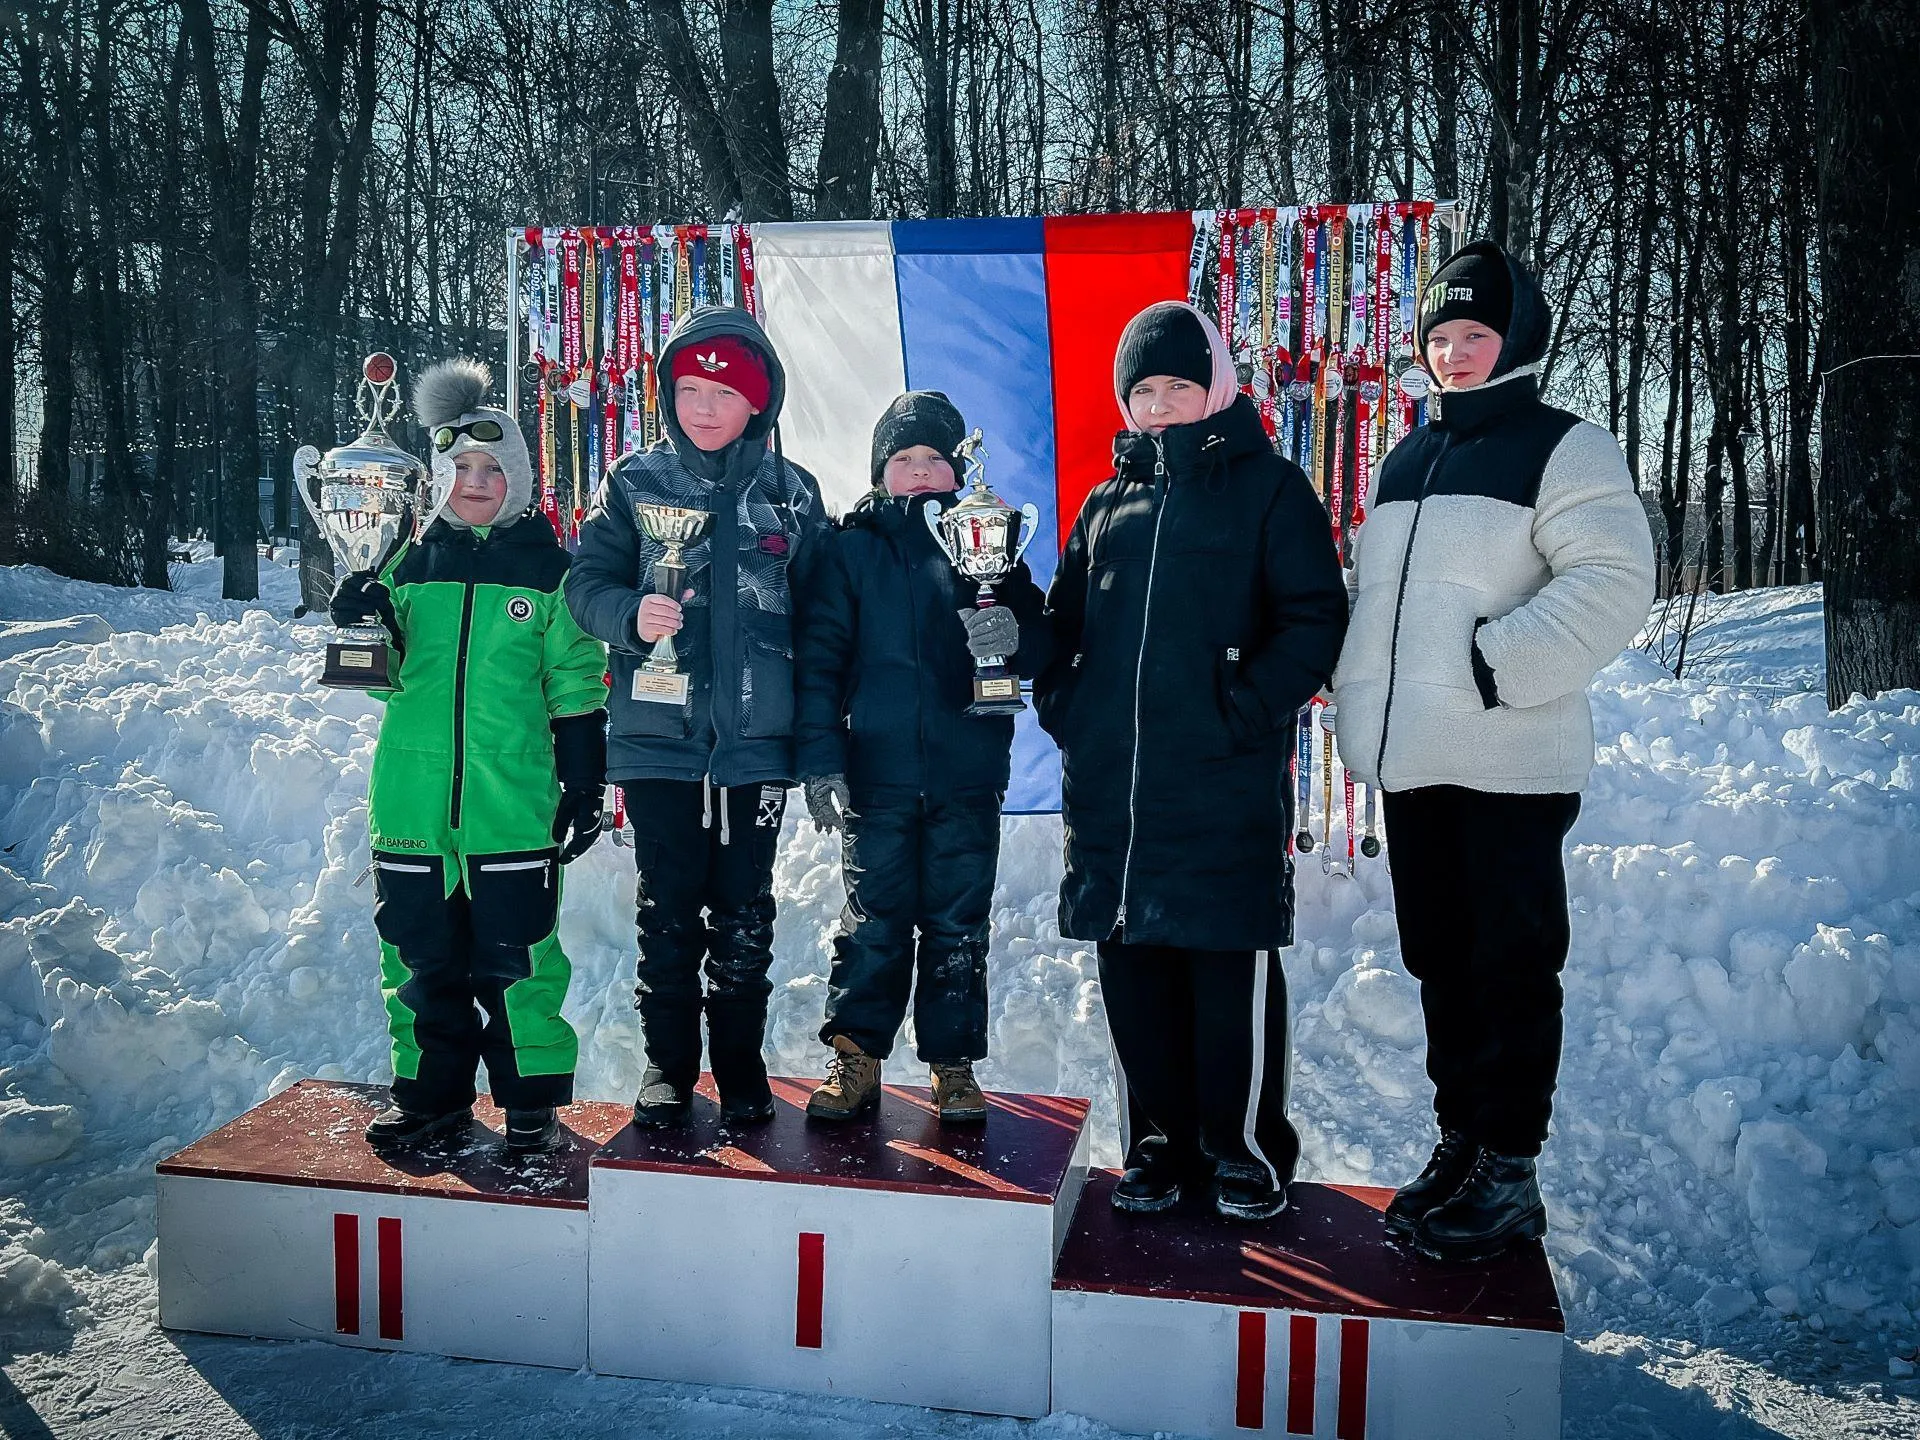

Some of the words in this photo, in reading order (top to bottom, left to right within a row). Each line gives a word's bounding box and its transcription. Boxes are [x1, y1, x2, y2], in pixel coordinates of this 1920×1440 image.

[723, 243, 733, 259] EAR
[1222, 234, 1231, 259] 2019
[1306, 229, 1316, 254] 2019
[1354, 244, 1365, 266] RACE
[1381, 230, 1390, 255] 2019
[568, 250, 577, 273] 2019
[625, 254, 635, 277] 2019
[741, 248, 754, 271] 2019
[680, 271, 690, 312] АН-ПРИ
[1220, 273, 1229, 307] ГОНКА
[1305, 269, 1315, 303] ГОНКА
[1332, 249, 1341, 308] ГРАН-ПРИ
[1380, 270, 1389, 304] ГОНКА
[1447, 287, 1473, 301] STER
[570, 287, 579, 318] ГОНКА
[585, 269, 593, 322] ГРАН-ПРИ
[627, 291, 636, 322] ГОНКА
[1355, 295, 1365, 319] 2018
[571, 320, 581, 367] АРОДНАЯ
[1304, 307, 1314, 354] АРОДНАЯ
[1379, 308, 1389, 359] АРОДНАЯ
[629, 325, 638, 369] РОДНАЯ
[646, 411, 655, 445] FINAL
[1358, 420, 1368, 454] ГОНКА
[1358, 456, 1368, 508] АРОДНАЯ
[387, 838, 428, 849] BAMBINO
